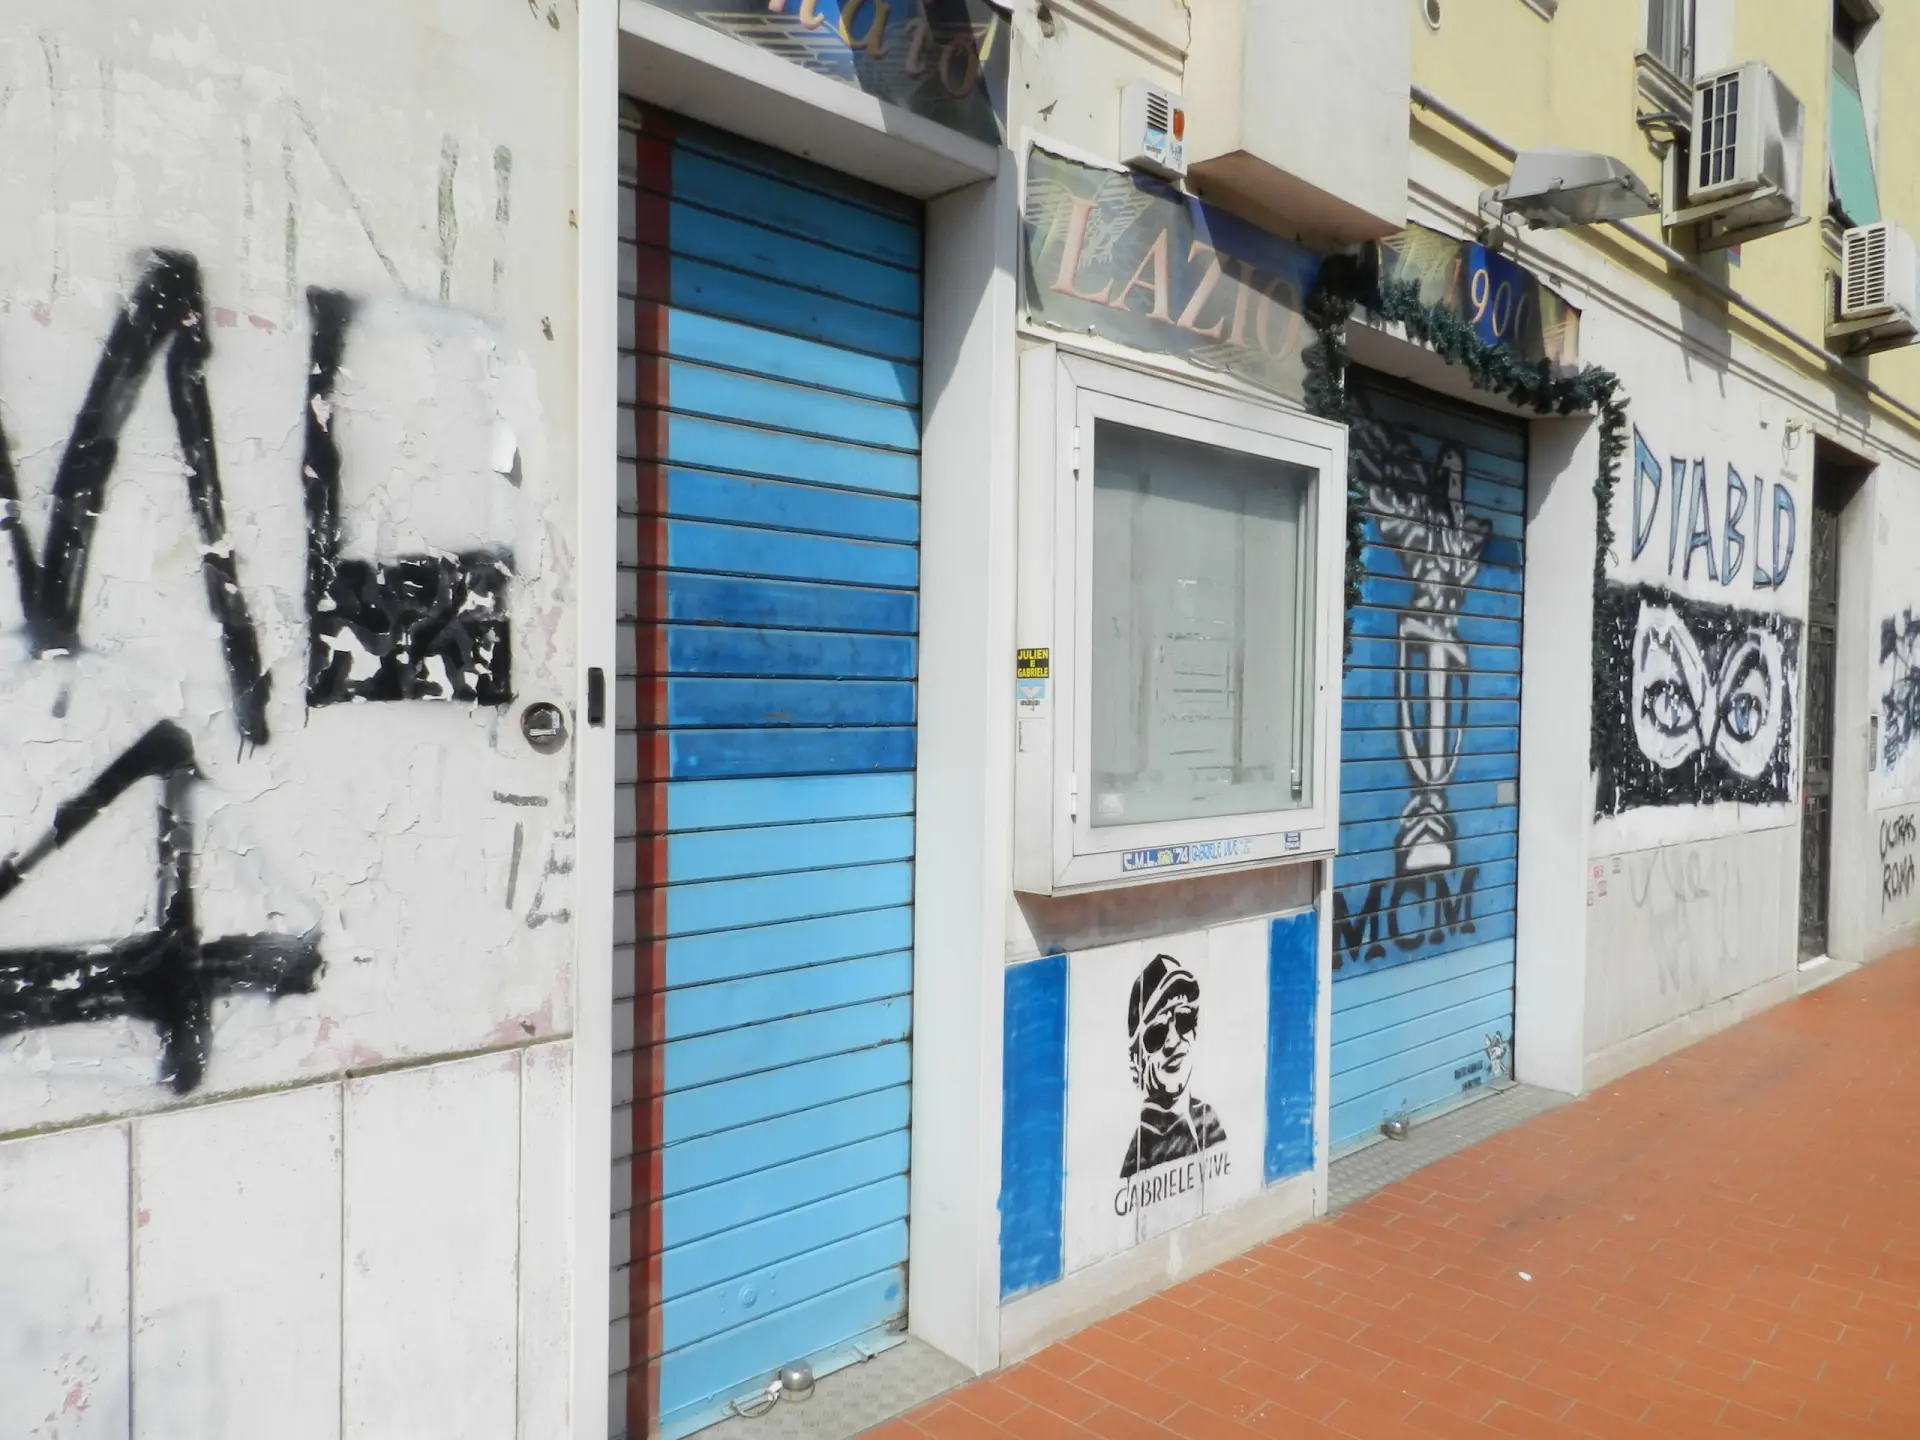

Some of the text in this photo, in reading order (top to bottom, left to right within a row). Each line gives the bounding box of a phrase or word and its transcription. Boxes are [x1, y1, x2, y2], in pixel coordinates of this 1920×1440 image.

[1049, 194, 1302, 361] LAZIO
[1018, 650, 1048, 660] JULIEN
[1018, 668, 1048, 677] GABRIELE
[1881, 853, 1915, 914] ROMA
[1332, 867, 1480, 972] MCM
[1115, 1162, 1195, 1216] GABRIELE
